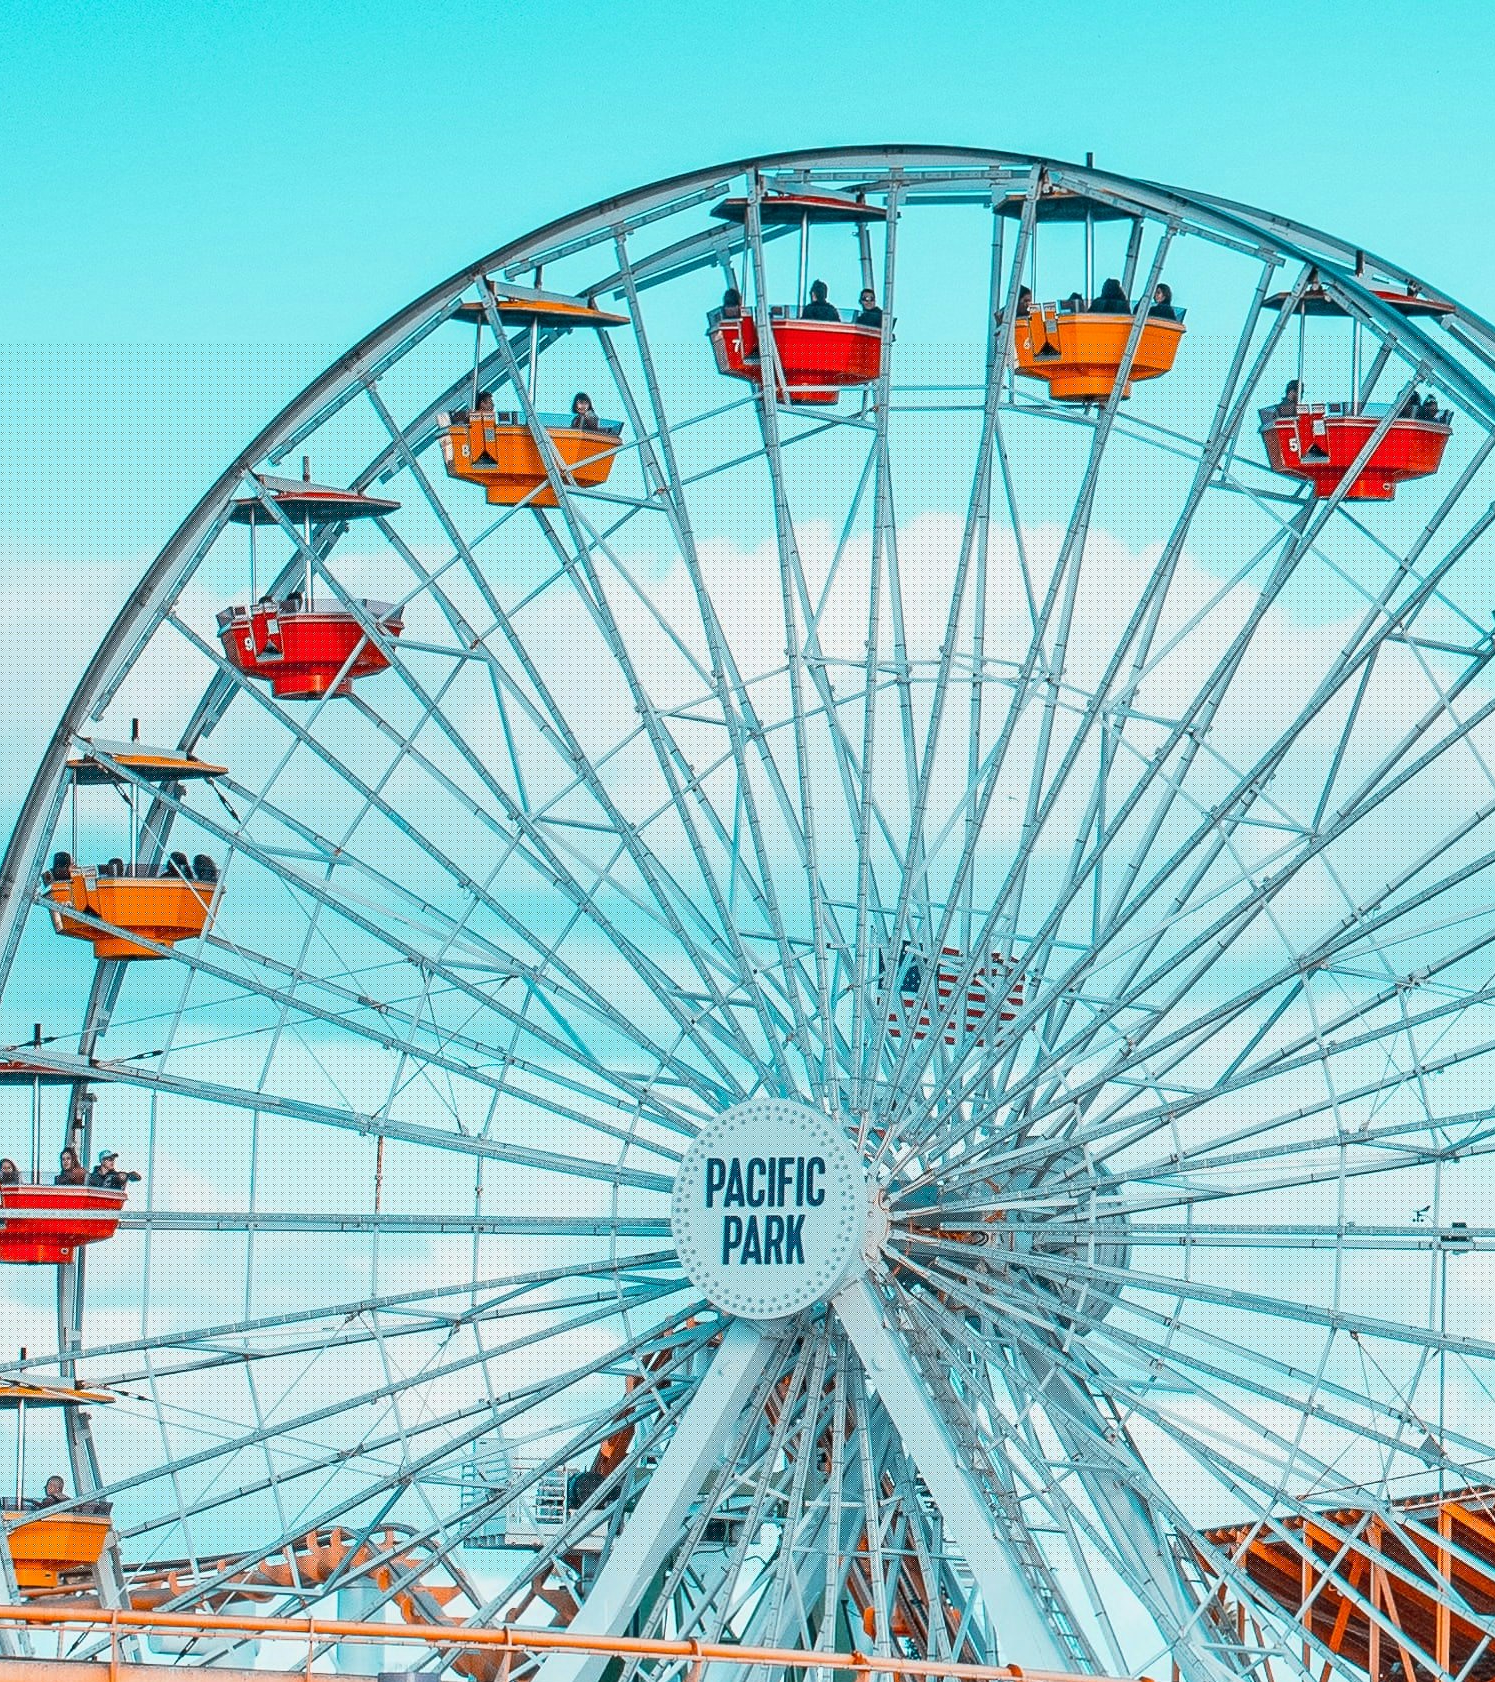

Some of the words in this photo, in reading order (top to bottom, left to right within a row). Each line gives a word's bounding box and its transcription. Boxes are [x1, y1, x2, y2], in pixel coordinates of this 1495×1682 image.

[732, 338, 741, 353] 7
[461, 444, 470, 457] 8
[1289, 438, 1299, 452] 5
[245, 637, 254, 651] 9
[706, 1156, 826, 1208] PACIFIC
[722, 1214, 805, 1265] PARK
